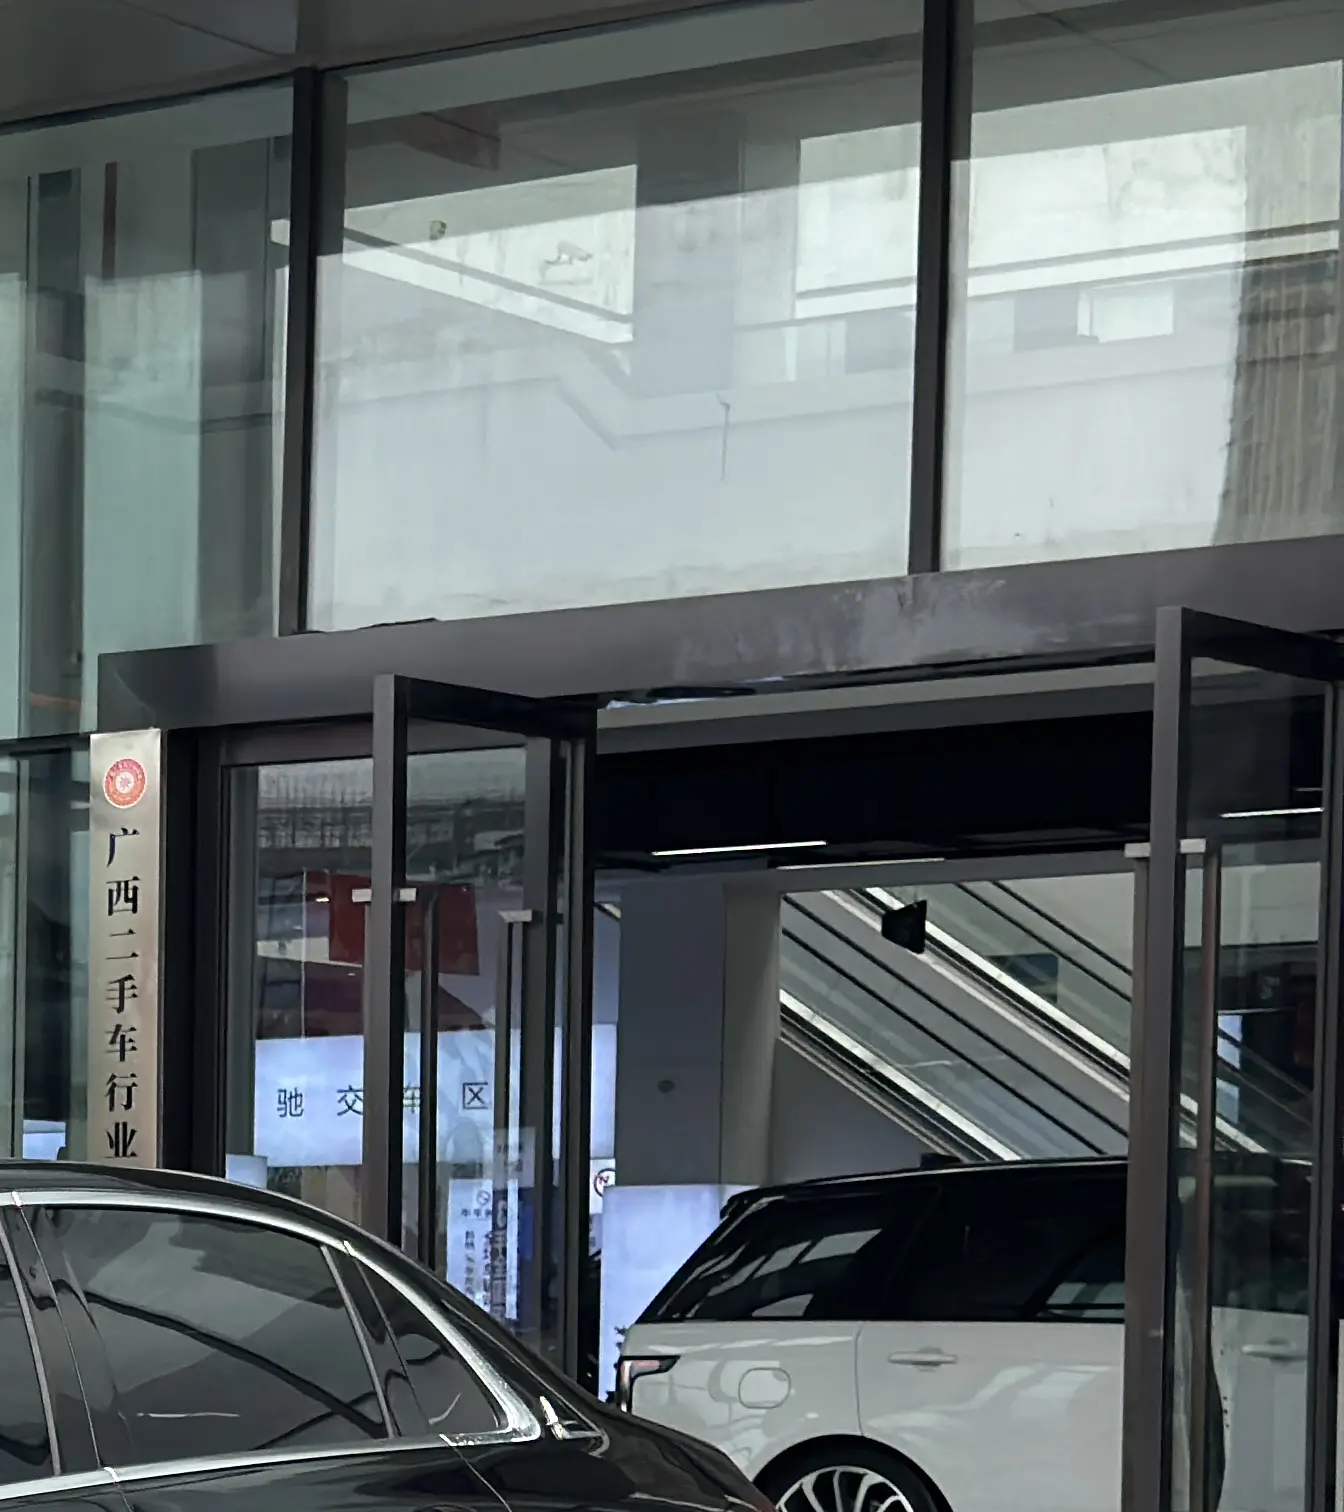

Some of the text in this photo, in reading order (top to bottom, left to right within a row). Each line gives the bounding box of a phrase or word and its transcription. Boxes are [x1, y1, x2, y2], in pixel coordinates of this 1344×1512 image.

[105, 827, 140, 1160] 广西二手车行业
